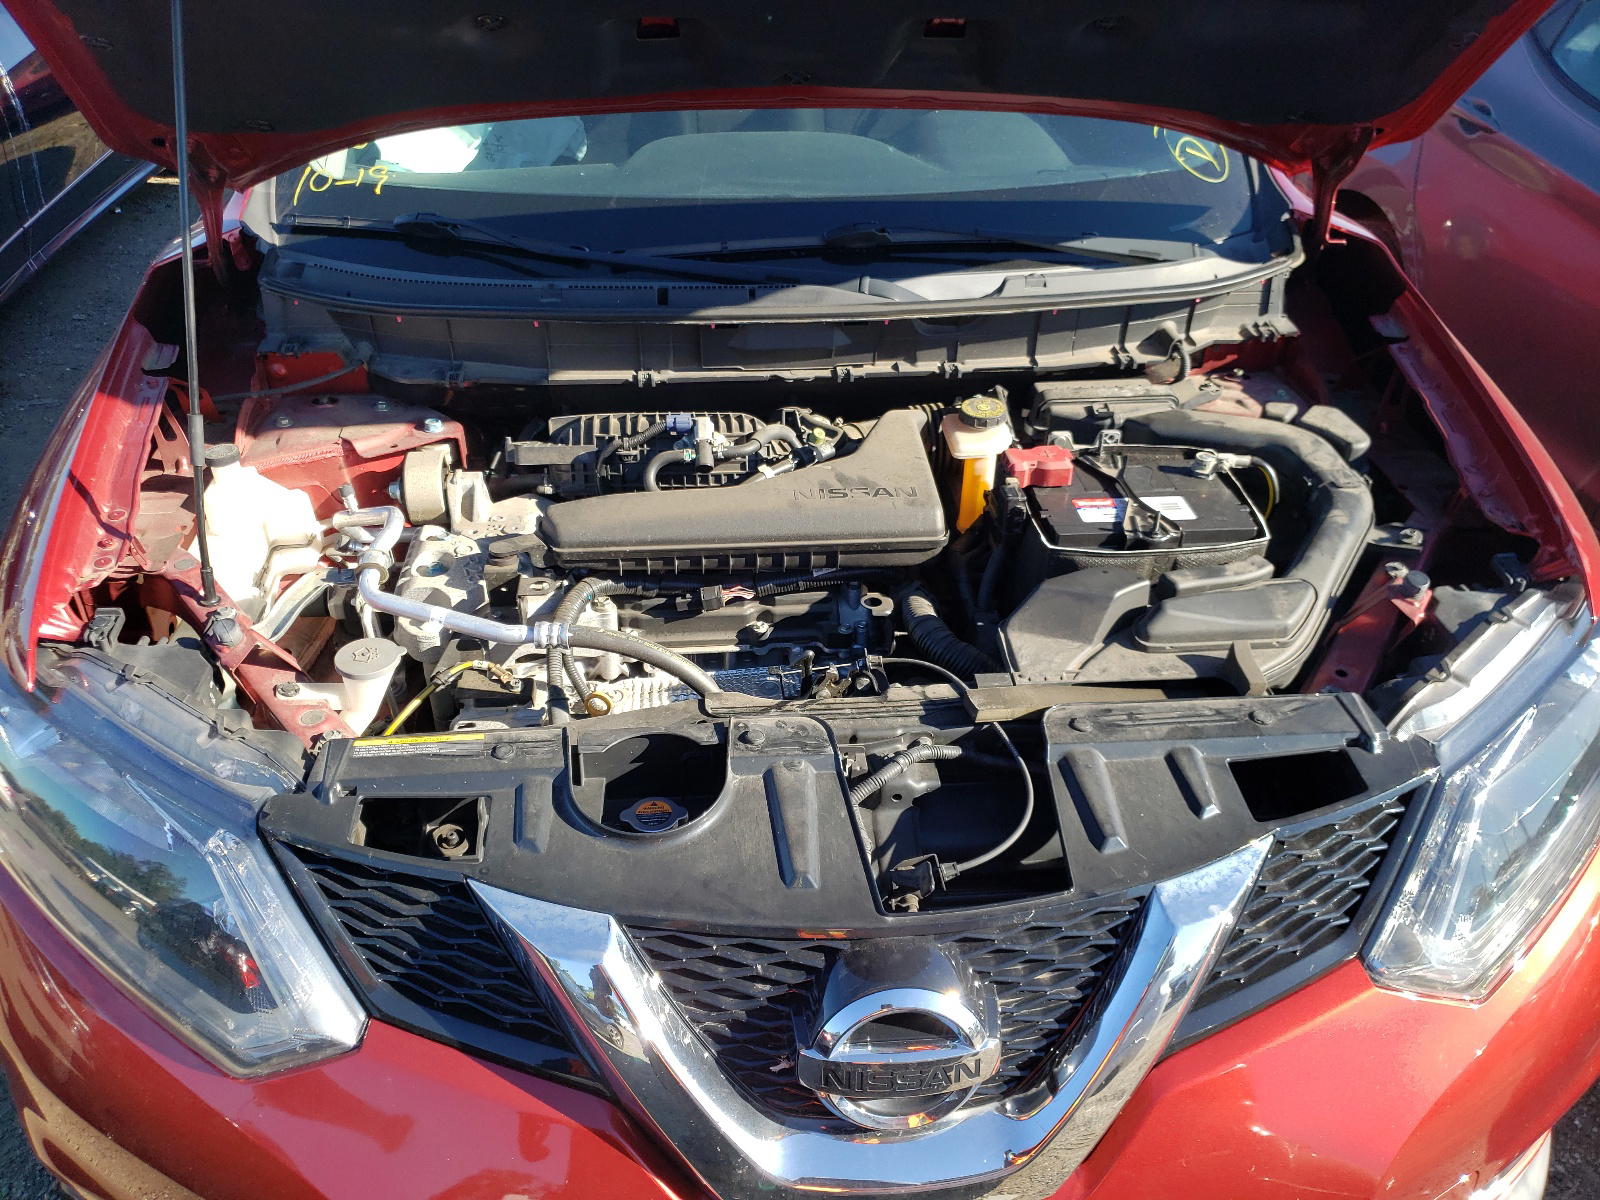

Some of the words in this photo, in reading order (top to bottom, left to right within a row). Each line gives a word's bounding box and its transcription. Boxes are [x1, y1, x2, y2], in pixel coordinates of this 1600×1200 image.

[293, 165, 389, 206] 10-19
[793, 486, 919, 501] NISSAN
[821, 1058, 981, 1092] NISSAN
